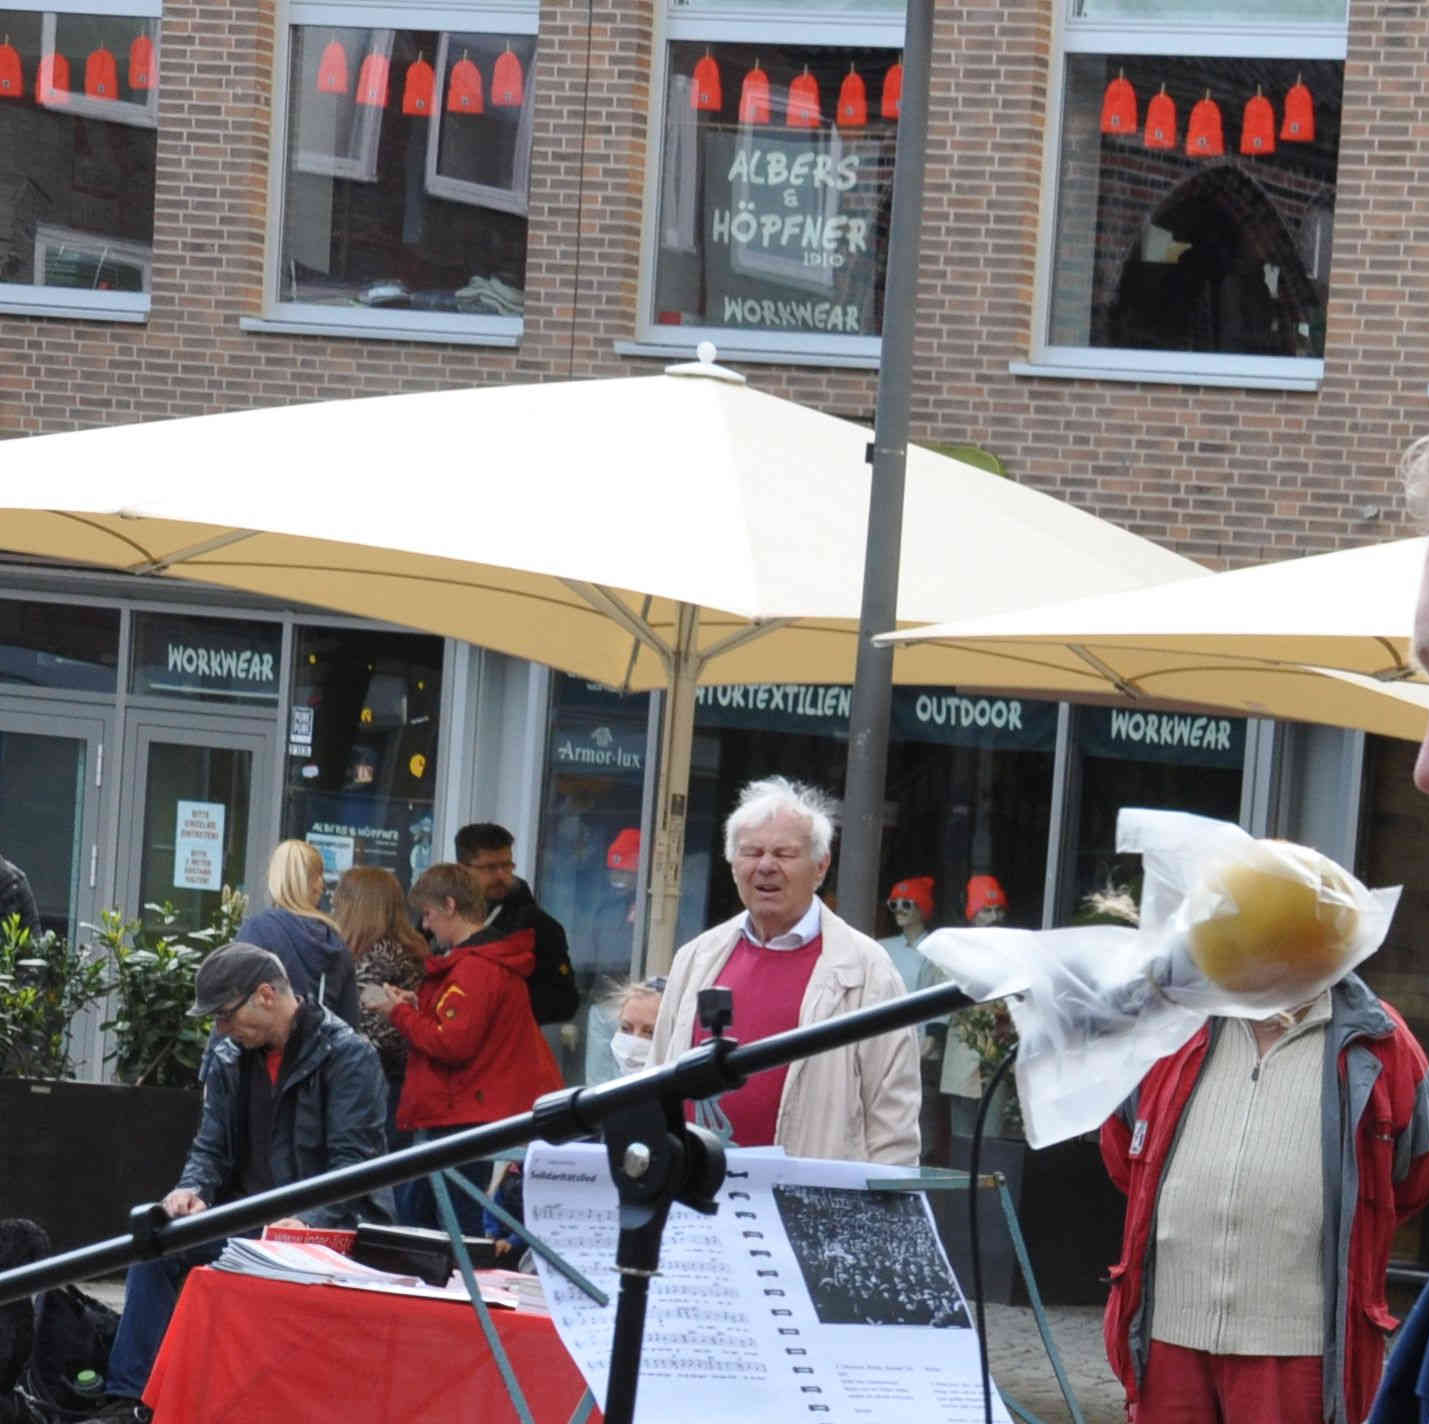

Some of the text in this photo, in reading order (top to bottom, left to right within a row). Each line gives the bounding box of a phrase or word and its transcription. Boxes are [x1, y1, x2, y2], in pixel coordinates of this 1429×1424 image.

[728, 150, 860, 190] ALBERS
[783, 188, 799, 207] &
[712, 201, 868, 254] HÖPFNER
[723, 296, 860, 332] WORKWEAR
[167, 643, 274, 682] WORKWEAR
[915, 694, 1023, 731] OUTDOOR
[1110, 709, 1232, 751] WORKWEAR
